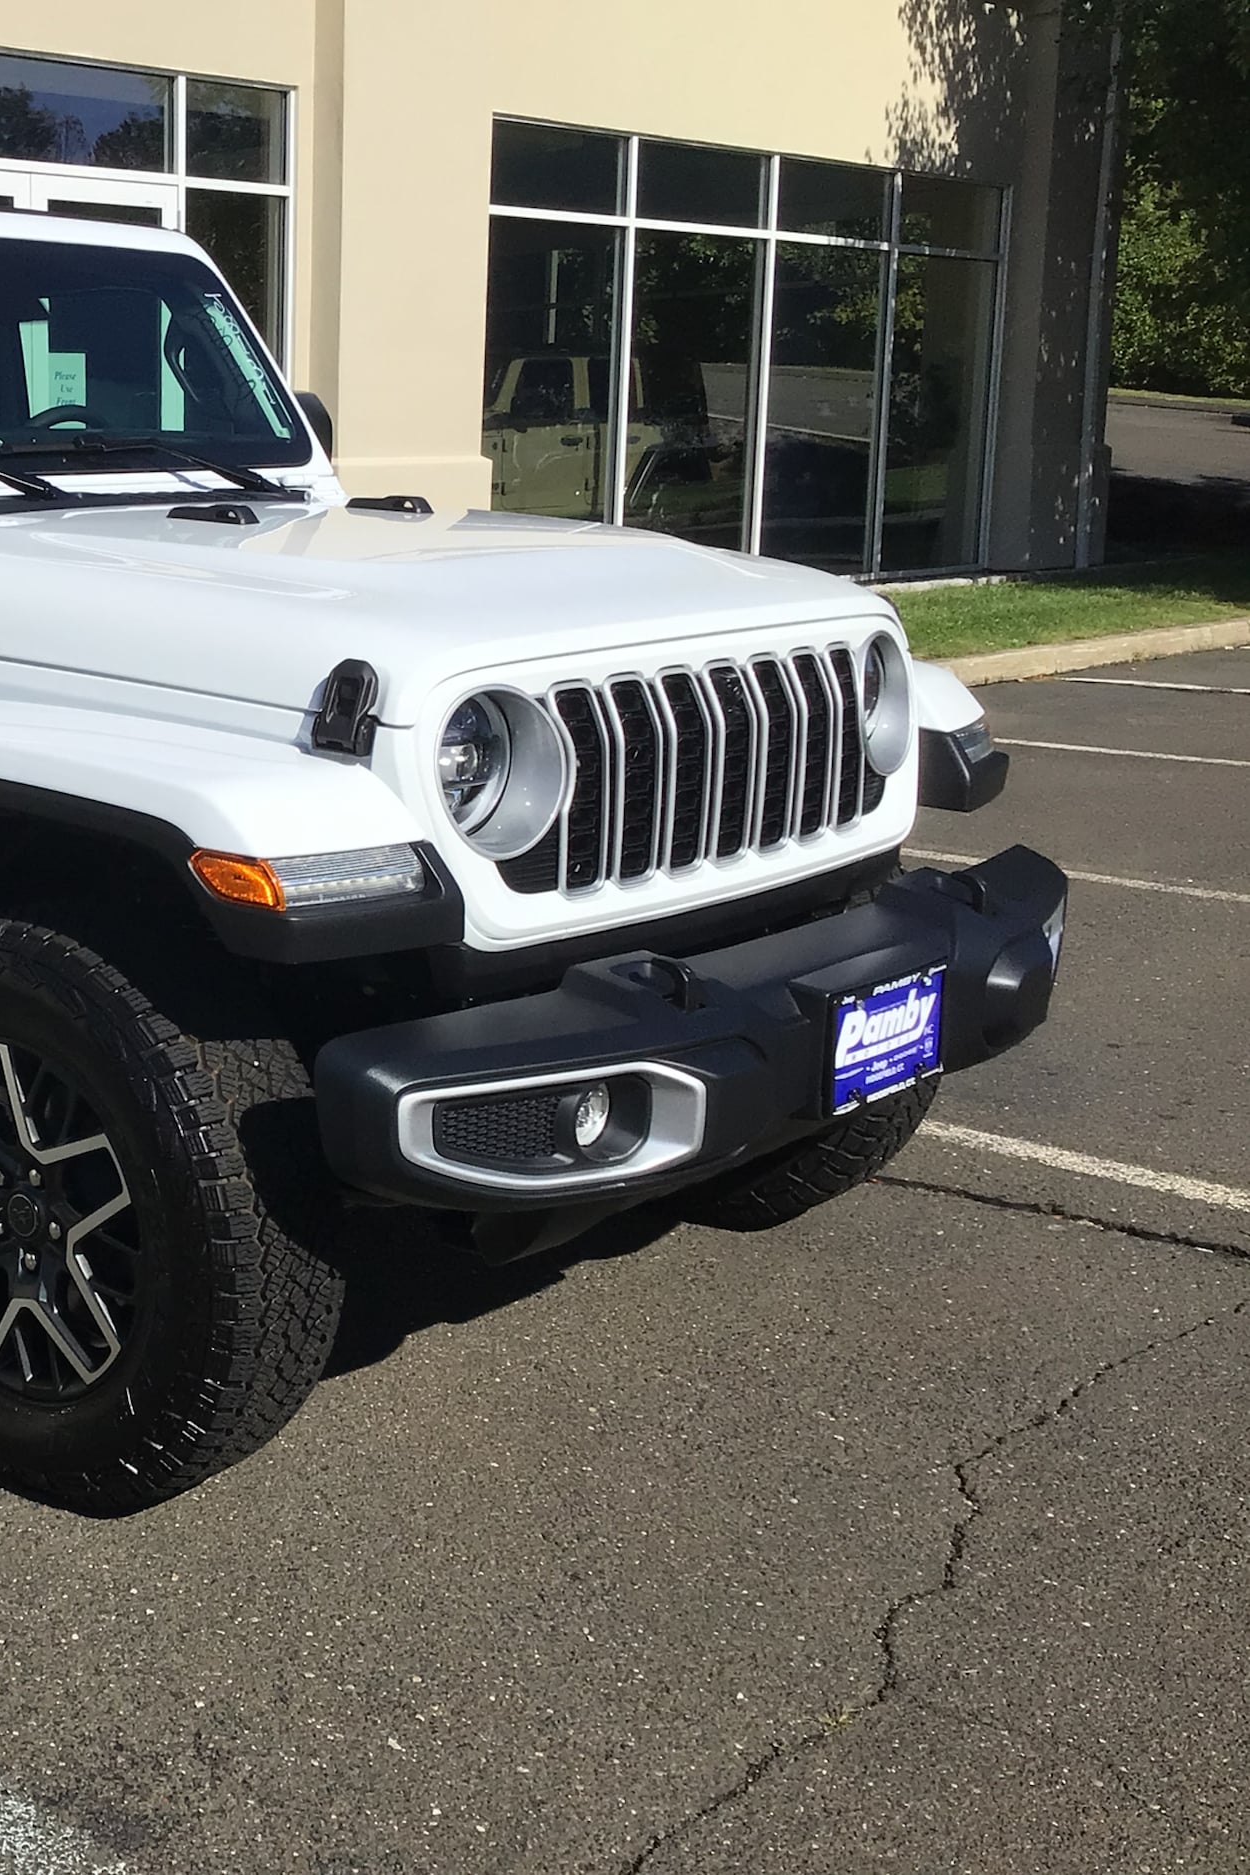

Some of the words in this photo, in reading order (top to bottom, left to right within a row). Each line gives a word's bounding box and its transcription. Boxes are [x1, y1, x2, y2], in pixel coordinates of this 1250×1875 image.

[54, 371, 77, 380] Please
[60, 384, 74, 393] Use
[872, 972, 922, 997] PAMBY
[835, 988, 938, 1069] Pamby
